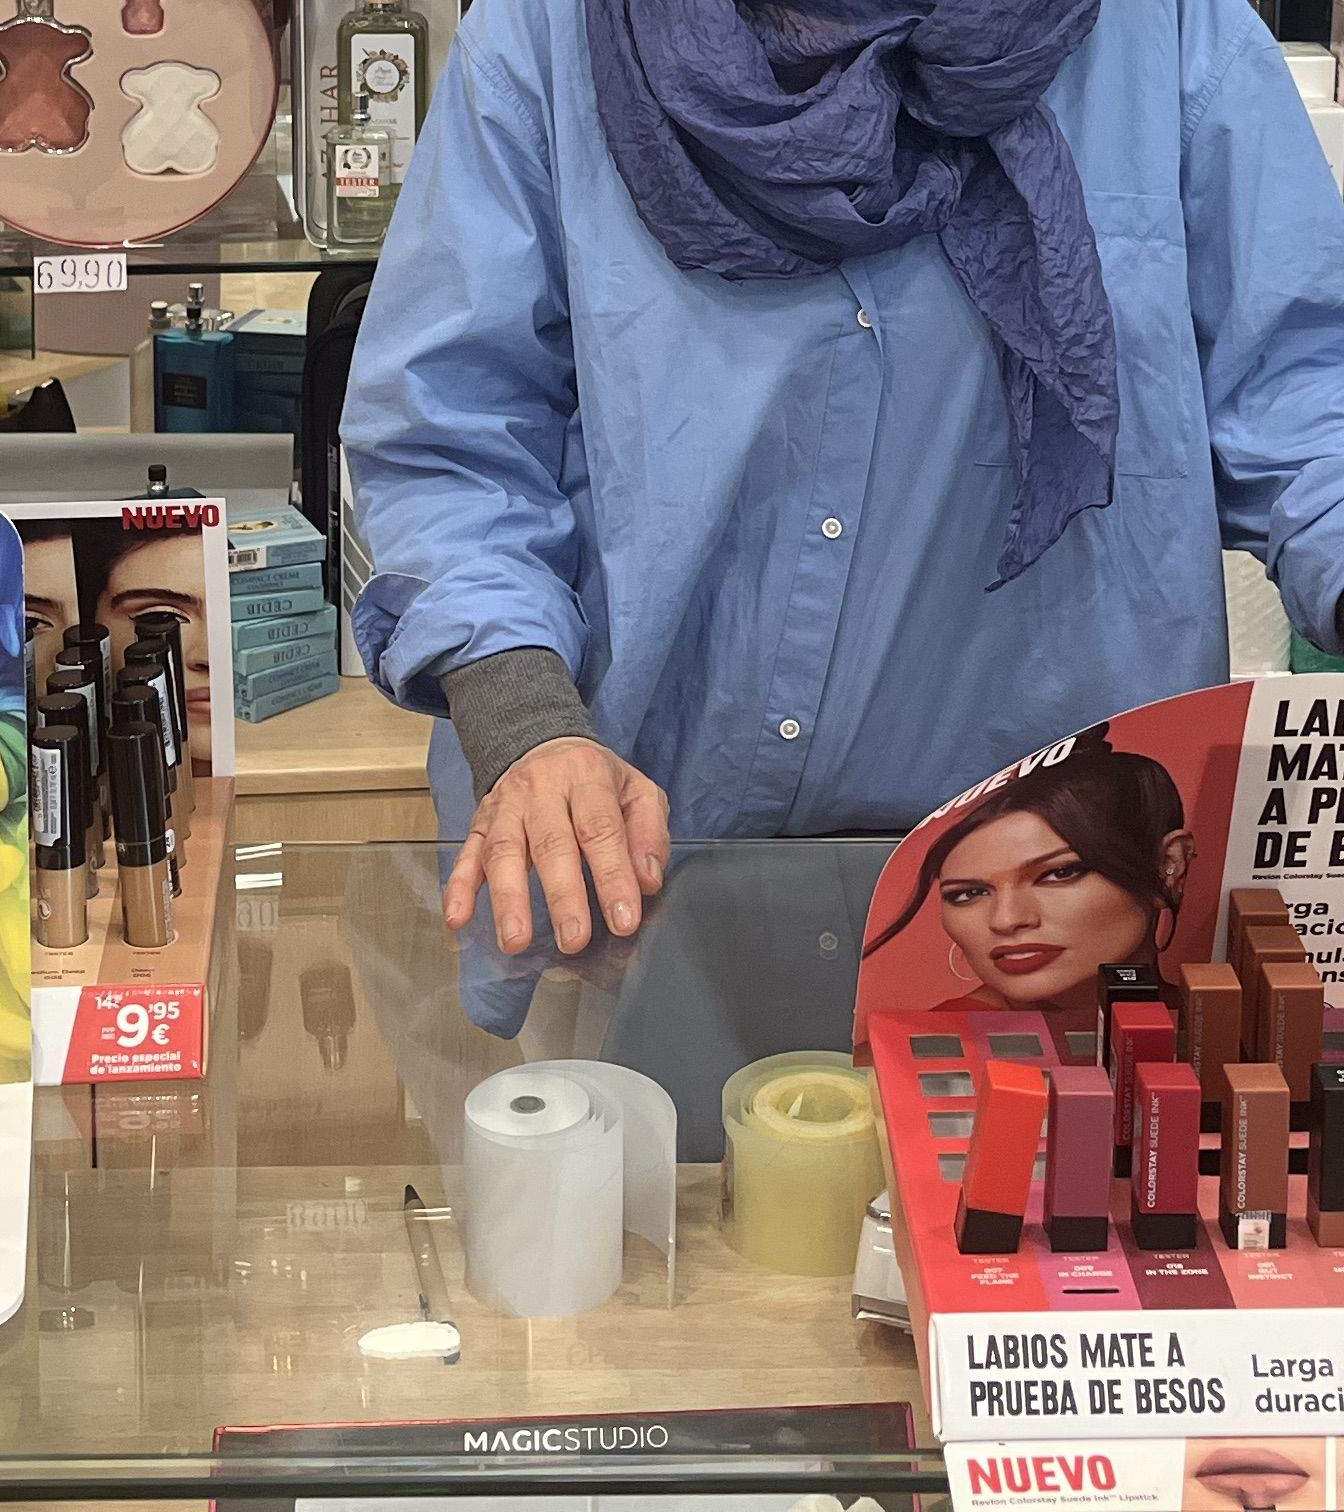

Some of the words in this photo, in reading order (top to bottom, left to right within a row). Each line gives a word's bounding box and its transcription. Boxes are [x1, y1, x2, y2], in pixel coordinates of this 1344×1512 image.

[121, 505, 220, 530] NUEVO
[1258, 787, 1288, 826] A
[1254, 828, 1310, 869] DE
[967, 1333, 1068, 1370] LABIOS
[1080, 1333, 1155, 1368] MATE
[1167, 1332, 1185, 1368] A
[1252, 1353, 1334, 1382] Larga
[970, 1379, 1078, 1416] PRUEBA
[1090, 1379, 1124, 1415] DE
[1136, 1377, 1225, 1414] BESOS
[464, 1424, 669, 1452] MAGICSTUDIO
[967, 1455, 1117, 1495] NUEVO
